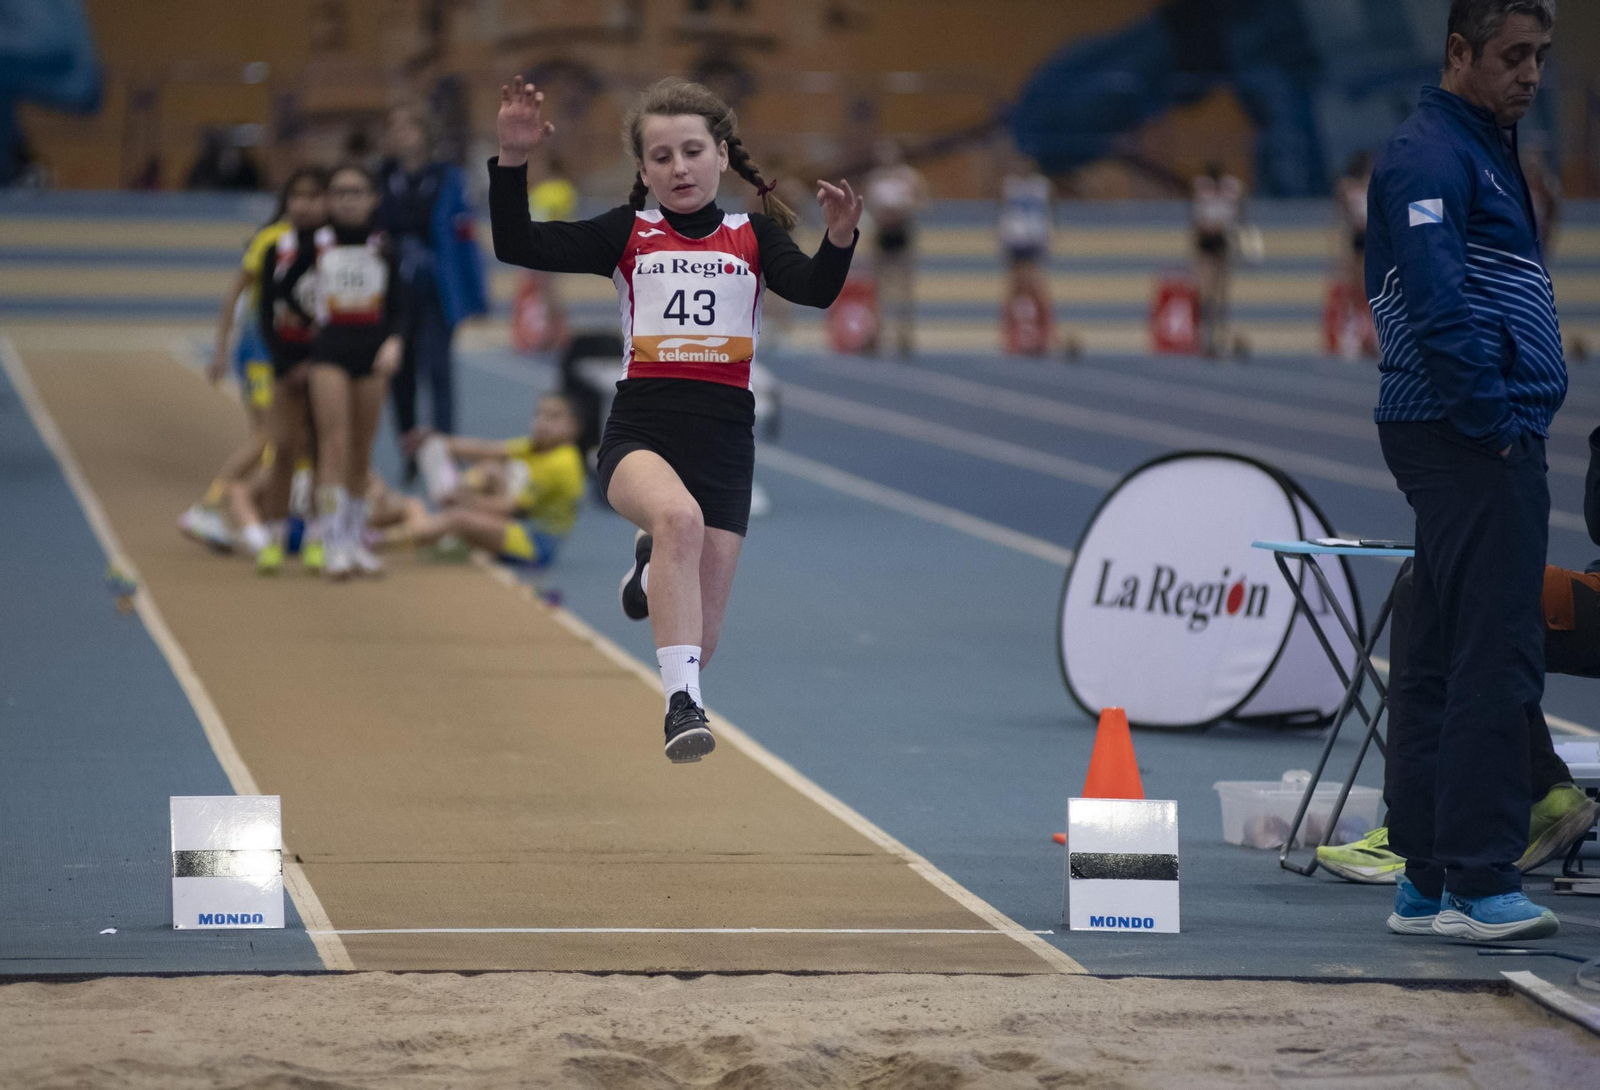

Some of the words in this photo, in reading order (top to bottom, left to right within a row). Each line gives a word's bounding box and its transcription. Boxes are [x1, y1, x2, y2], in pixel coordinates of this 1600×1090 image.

[636, 261, 666, 275] La
[663, 289, 716, 326] 43
[658, 349, 730, 363] telemiño
[1092, 558, 1140, 609] La
[198, 913, 264, 925] MONDO
[1090, 915, 1154, 929] MONDO
